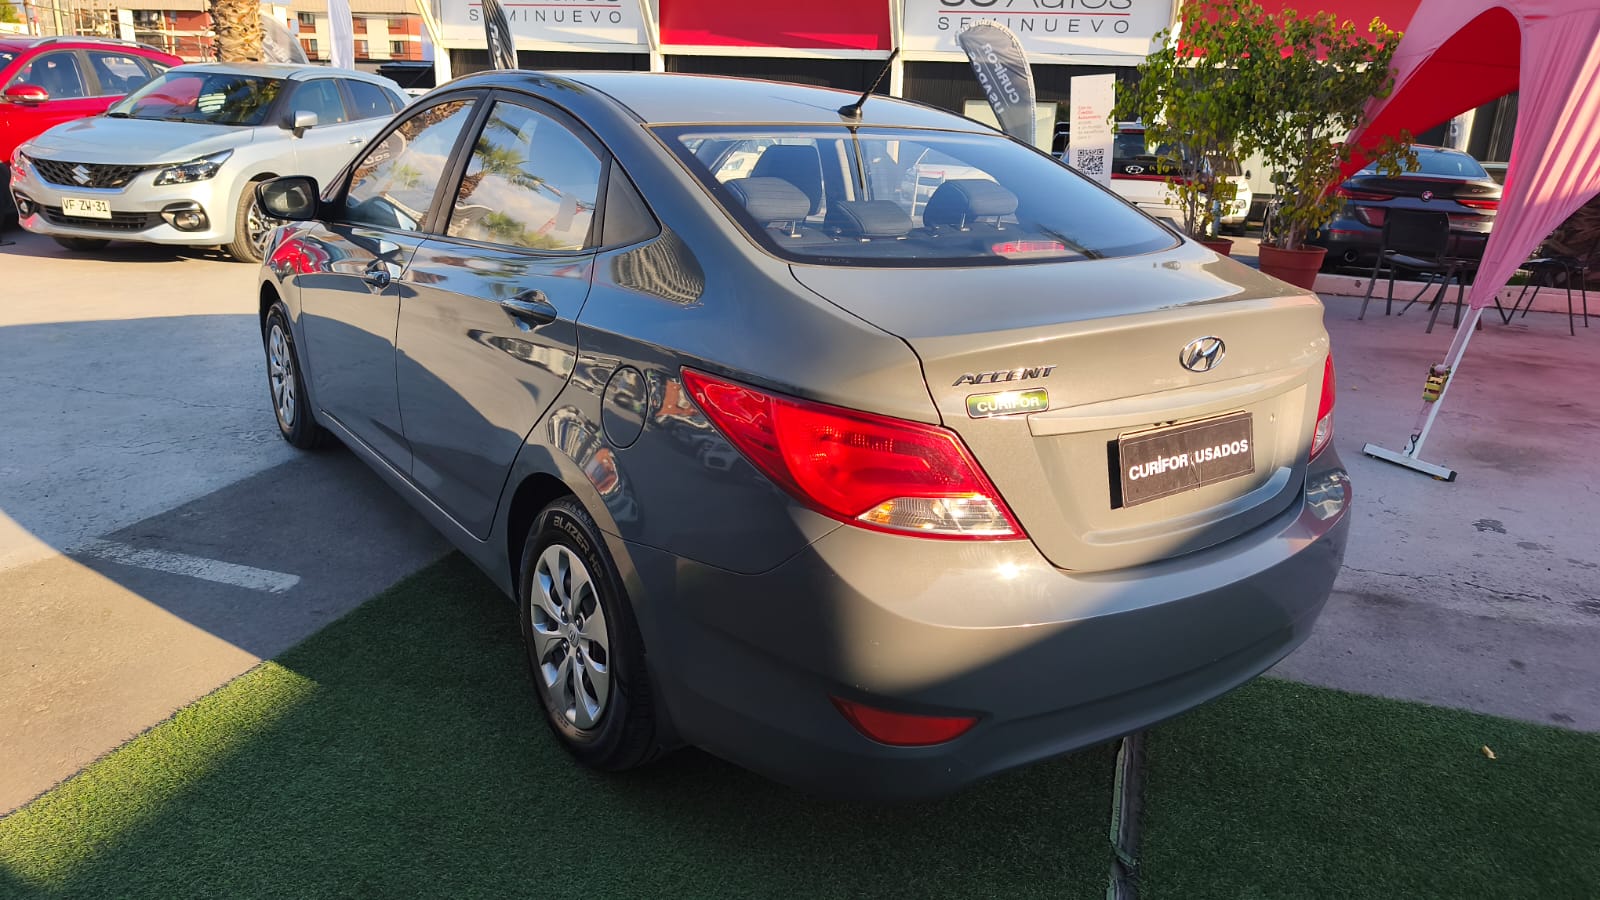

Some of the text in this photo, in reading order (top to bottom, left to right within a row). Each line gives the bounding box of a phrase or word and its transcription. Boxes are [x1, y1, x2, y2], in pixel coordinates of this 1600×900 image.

[937, 16, 1130, 34] SEINUEVO
[952, 364, 1056, 386] ACCENT
[1194, 439, 1249, 464] USADOS
[553, 515, 590, 554] BLAZER
